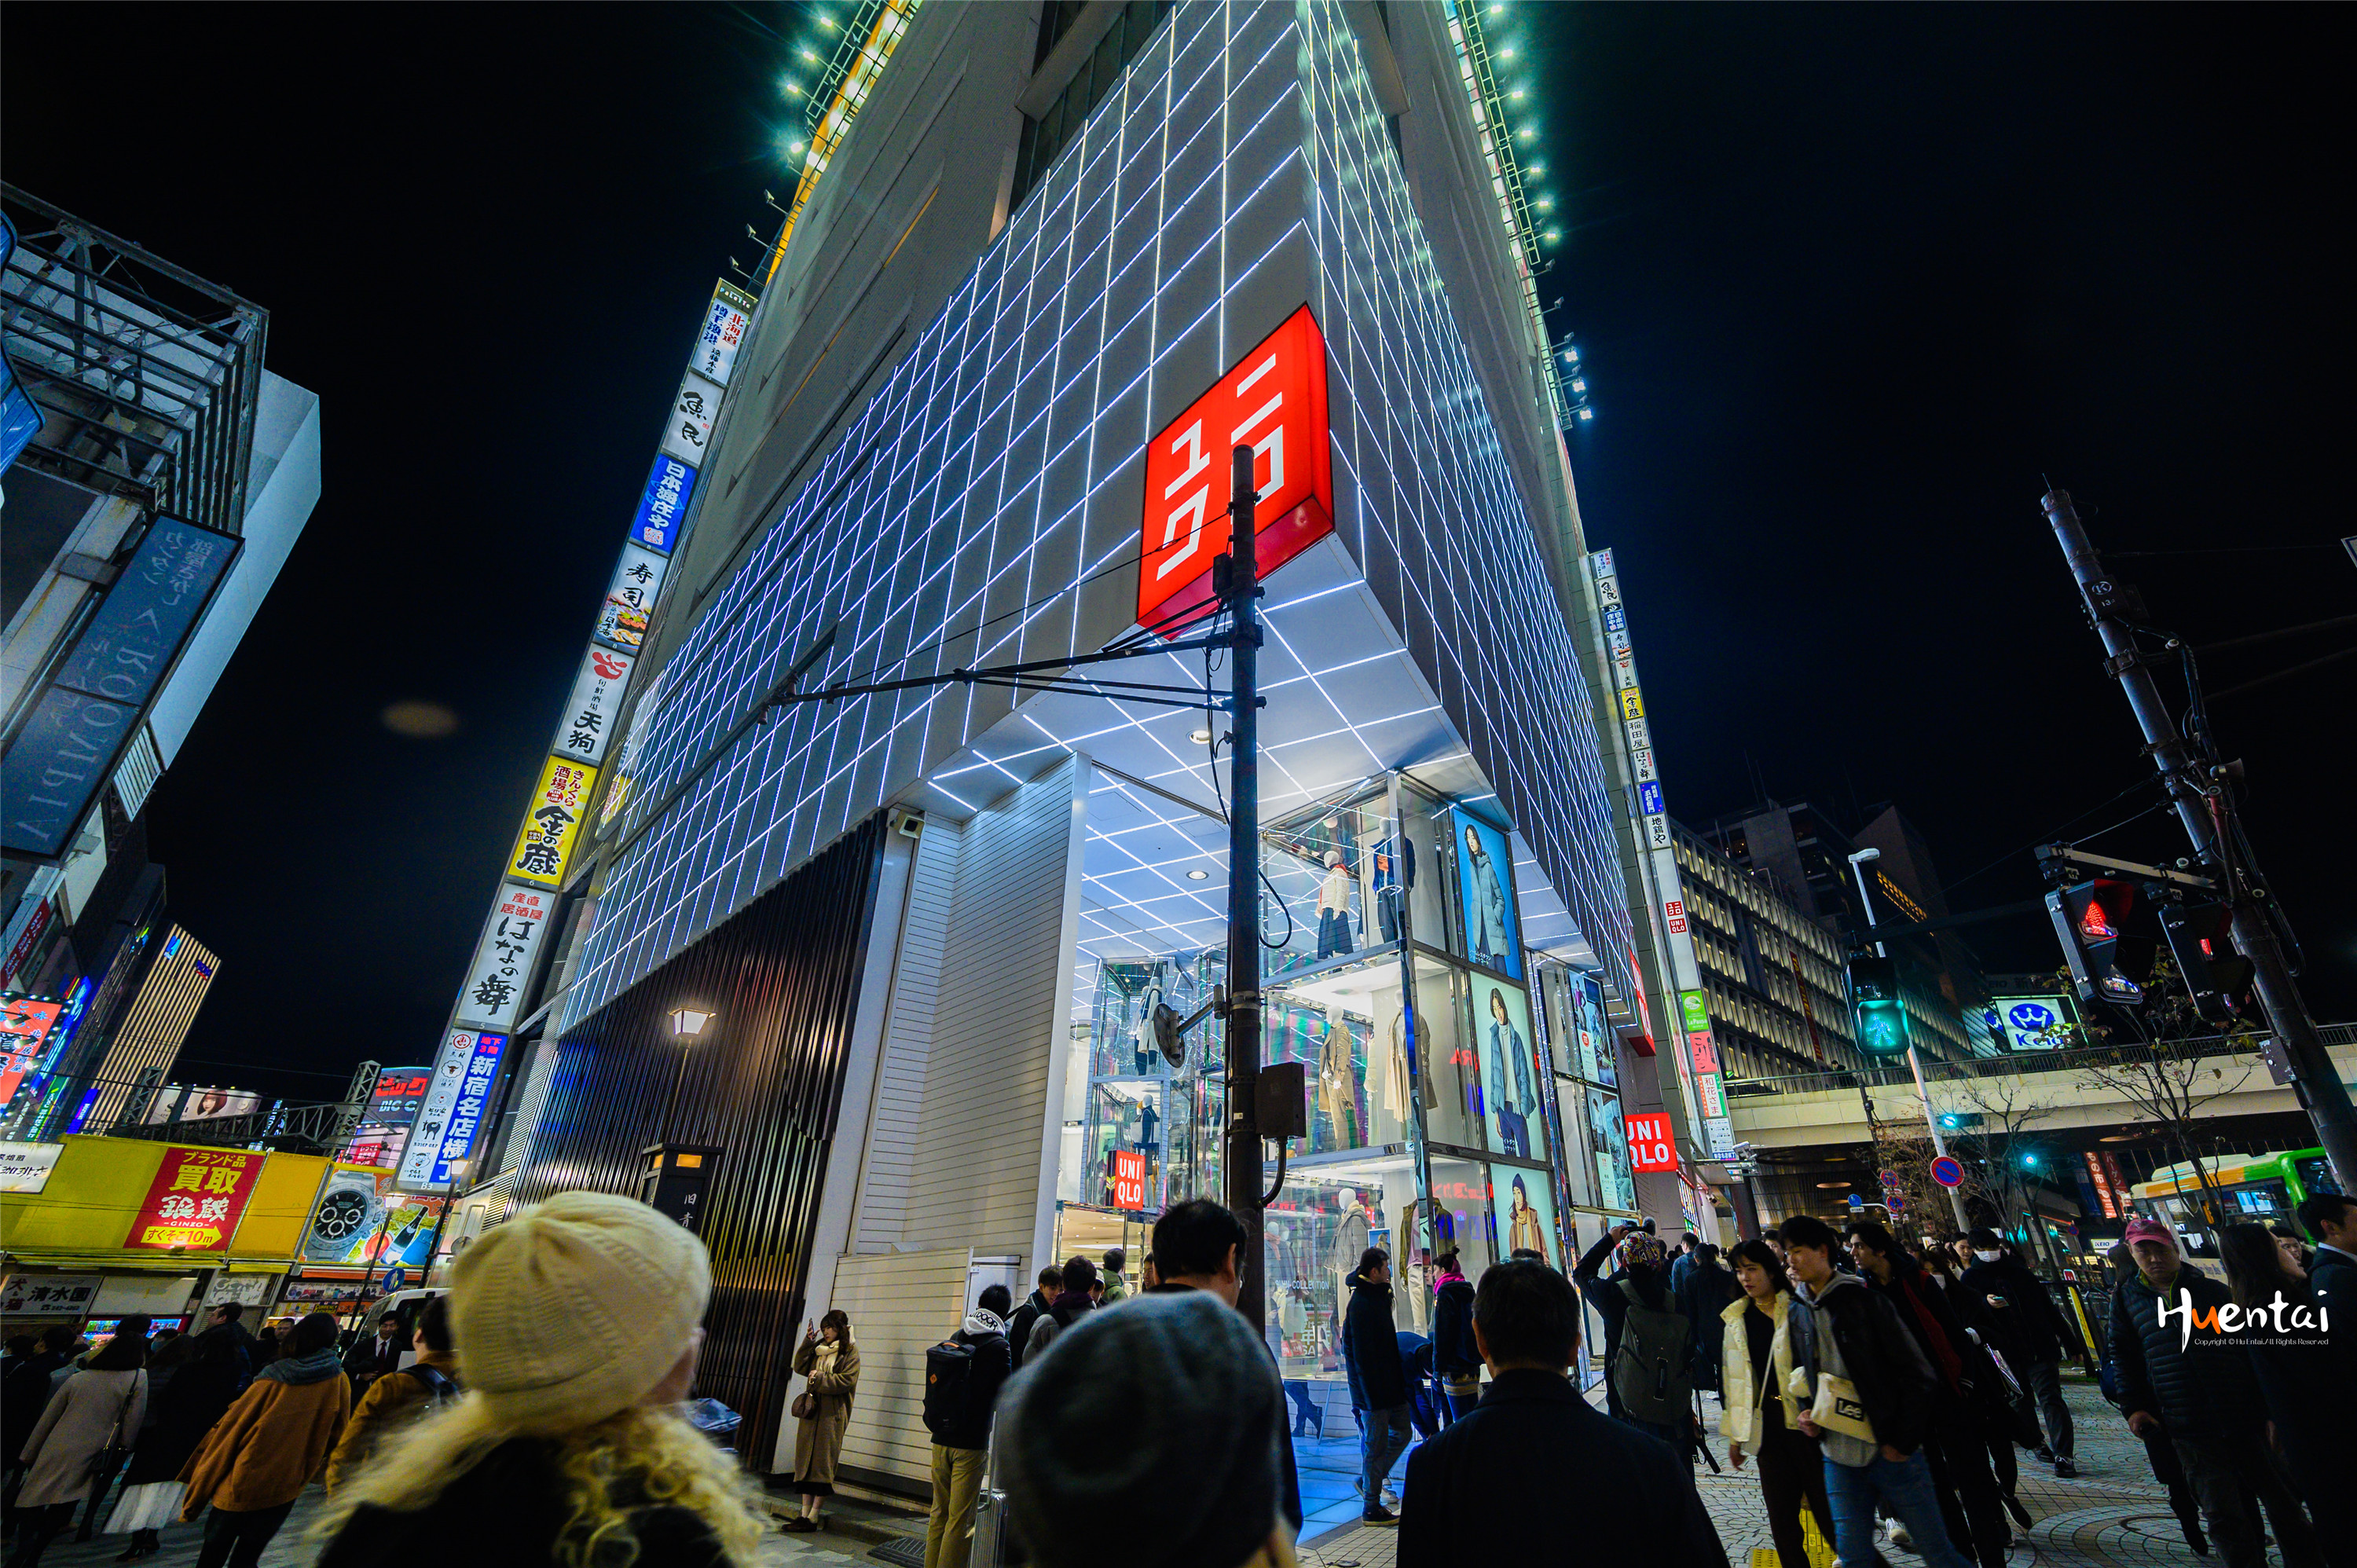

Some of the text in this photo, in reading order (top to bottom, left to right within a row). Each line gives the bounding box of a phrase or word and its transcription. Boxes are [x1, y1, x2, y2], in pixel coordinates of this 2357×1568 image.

[722, 313, 746, 346] 北海道
[680, 391, 708, 447] 魚民
[622, 562, 654, 609] 寿司
[568, 710, 603, 754] 天狗
[1629, 721, 1645, 748] 稲田屋
[550, 765, 572, 790] 酒場
[564, 770, 585, 807] きんくら
[515, 805, 575, 875] 金の蔵
[500, 903, 543, 921] 居酒屋
[512, 892, 541, 907] 産直
[472, 916, 535, 1016] はなの舞
[481, 1036, 502, 1046] 地下
[1704, 1077, 1719, 1114] 和花さま
[438, 1055, 497, 1181] 新宿名店横丁
[1628, 1120, 1662, 1141] UNI
[182, 1152, 247, 1167] ブランド品
[1120, 1158, 1140, 1180] UNI
[1629, 1143, 1670, 1168] QLO
[168, 1164, 243, 1195] 買取
[1118, 1181, 1141, 1204] QLO
[158, 1195, 229, 1222] 銀蔵
[1838, 1400, 1862, 1418] Lee
